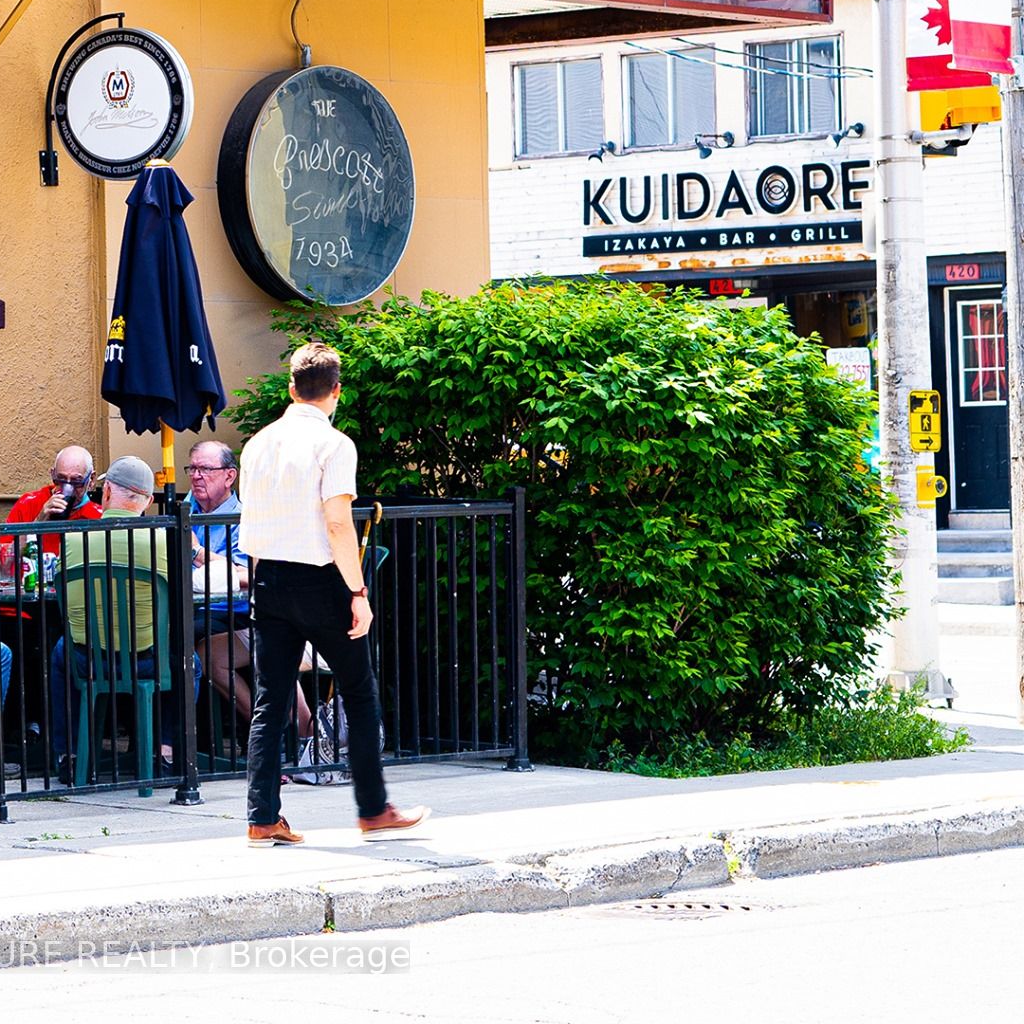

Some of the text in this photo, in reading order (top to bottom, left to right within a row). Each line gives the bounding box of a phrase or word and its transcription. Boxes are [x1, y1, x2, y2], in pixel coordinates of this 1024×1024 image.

[60, 49, 87, 92] BREWING
[86, 34, 123, 52] CANADA'S
[123, 34, 144, 46] BEST
[143, 39, 166, 62] SINCE
[111, 78, 125, 92] M
[78, 151, 112, 174] BRASSEUR
[112, 165, 132, 174] CHEZ
[582, 159, 872, 227] KUIDAORE
[603, 226, 850, 252] IZAKAYA BAR GRILL
[948, 265, 976, 278] 420
